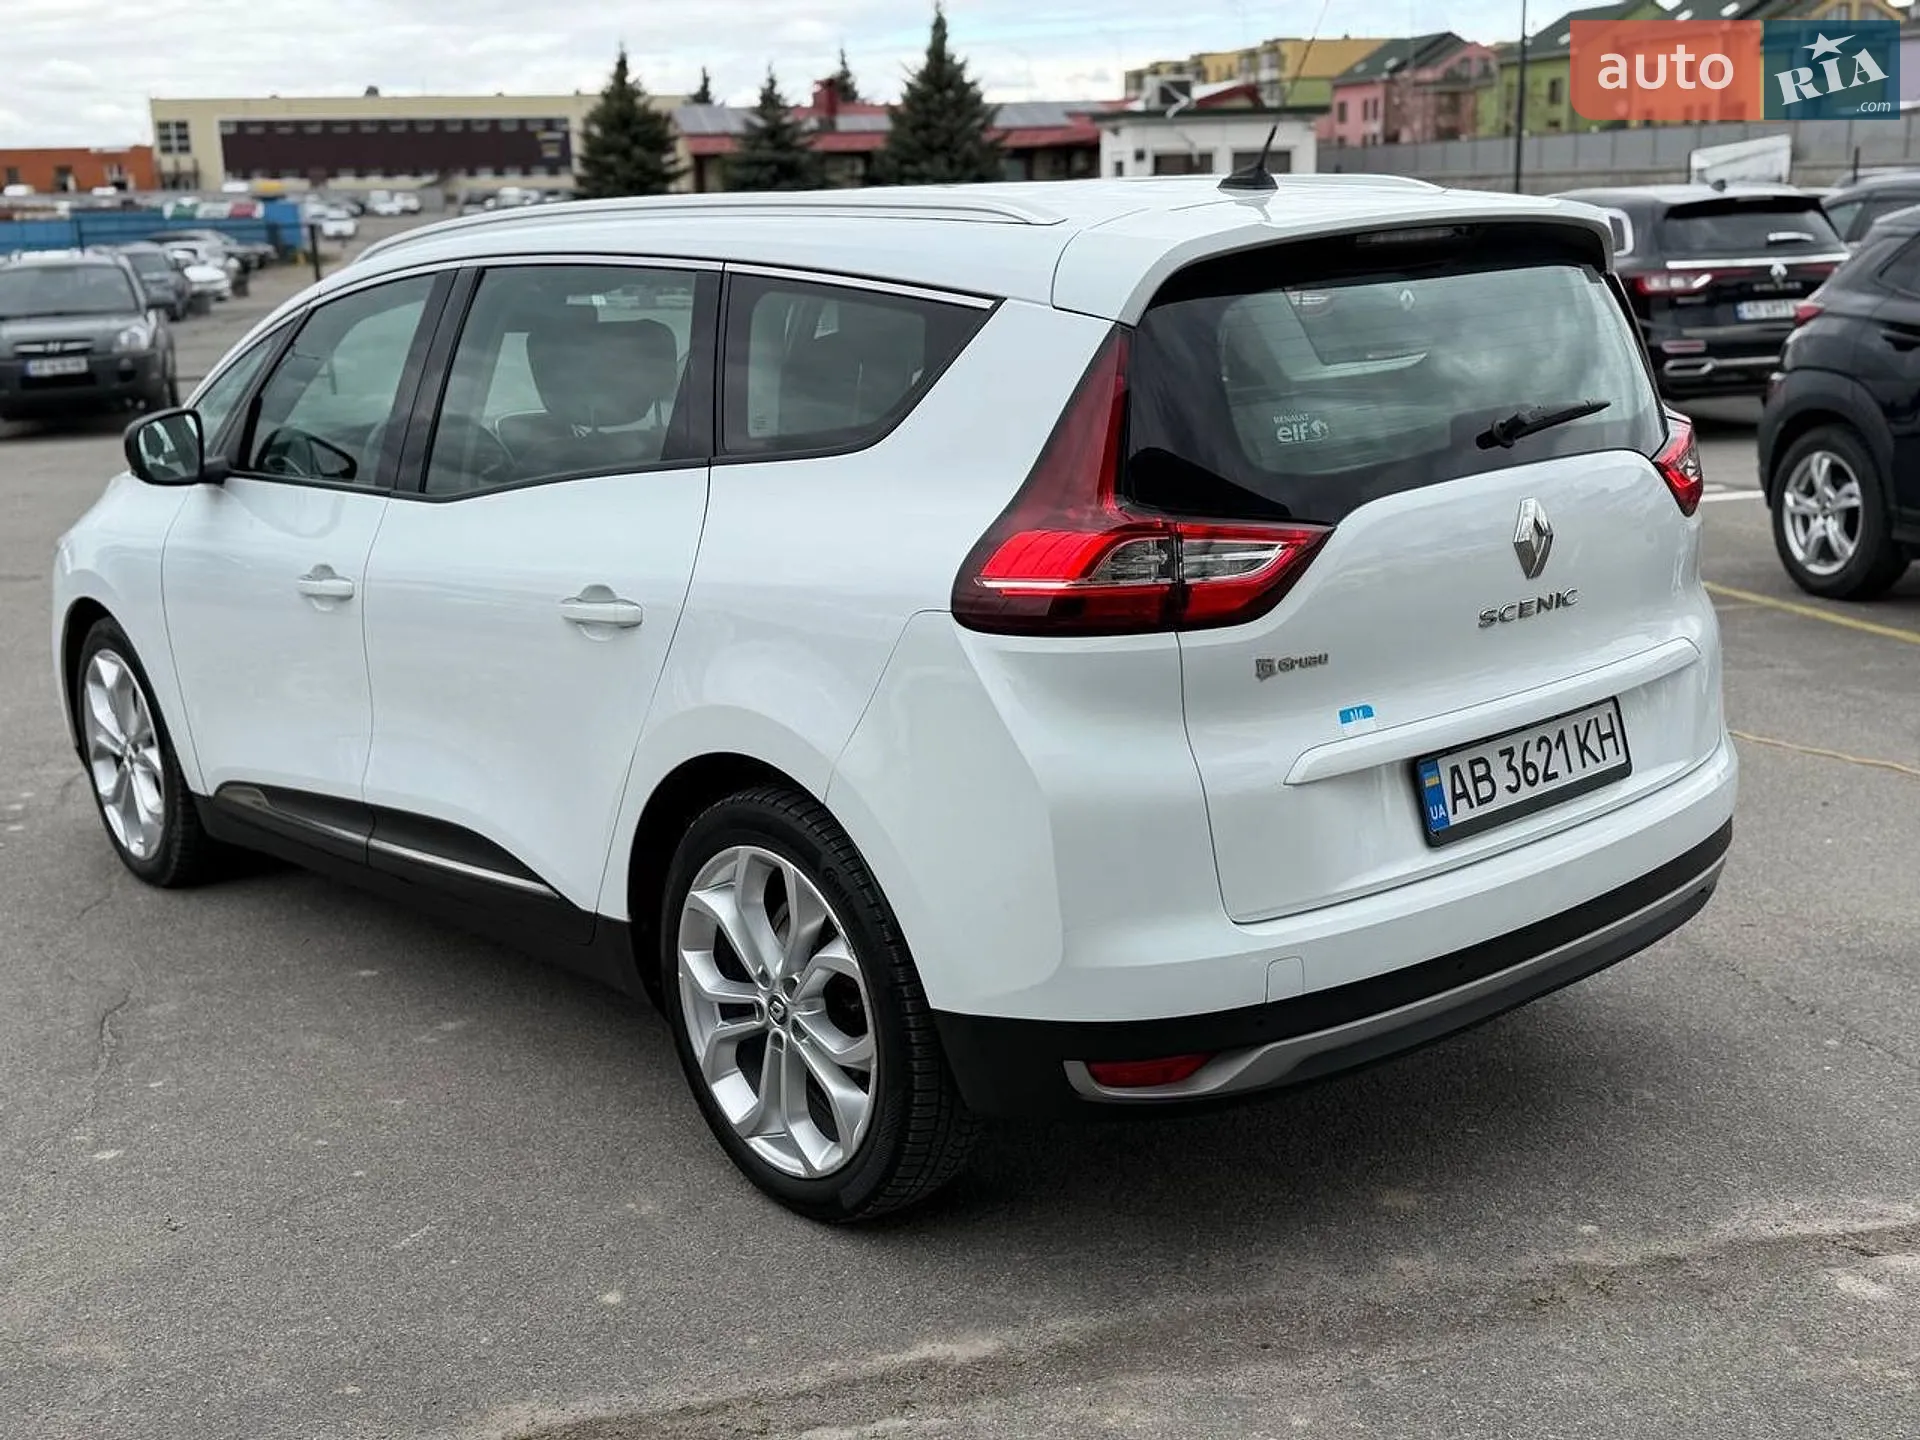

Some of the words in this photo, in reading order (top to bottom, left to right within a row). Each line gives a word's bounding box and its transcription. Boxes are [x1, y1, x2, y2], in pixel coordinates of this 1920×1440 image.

[1277, 422, 1309, 442] elf
[1478, 588, 1579, 628] SCENIC
[1449, 756, 1497, 815] AB
[1499, 728, 1573, 794] 3621
[1574, 712, 1620, 769] KH
[1430, 805, 1448, 820] UA
